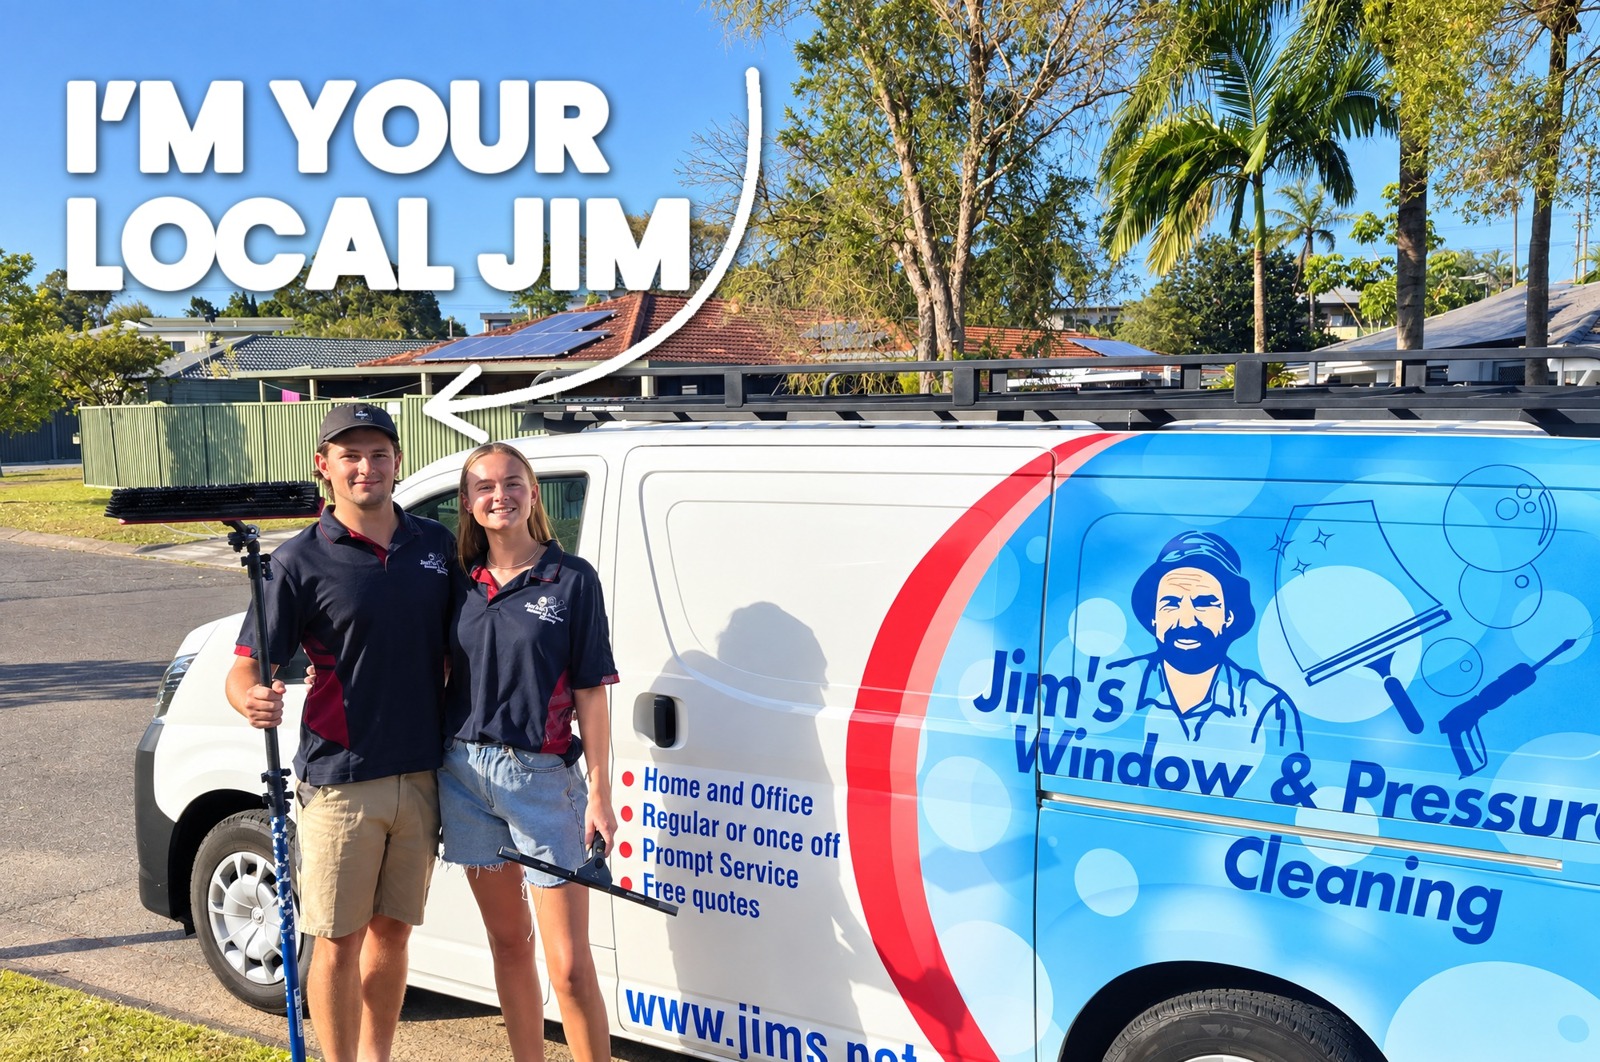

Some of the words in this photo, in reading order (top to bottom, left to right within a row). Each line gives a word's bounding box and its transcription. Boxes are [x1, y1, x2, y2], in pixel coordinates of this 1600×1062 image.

[973, 648, 1126, 723] Jim's
[643, 766, 701, 800] Home
[706, 779, 745, 807] and
[751, 783, 814, 817] Office
[1014, 724, 1253, 799] Window
[1270, 751, 1318, 809] &
[1343, 759, 1600, 842] Pressur
[642, 802, 720, 839] Regular
[725, 821, 747, 843] or
[753, 825, 804, 853] once
[810, 831, 841, 860] off
[642, 837, 714, 879] Prompt
[719, 852, 799, 890] Service
[643, 872, 687, 905] Free
[692, 890, 760, 920] quotes
[1224, 834, 1503, 945] Cleaning
[625, 988, 917, 1062] www.jimsn
